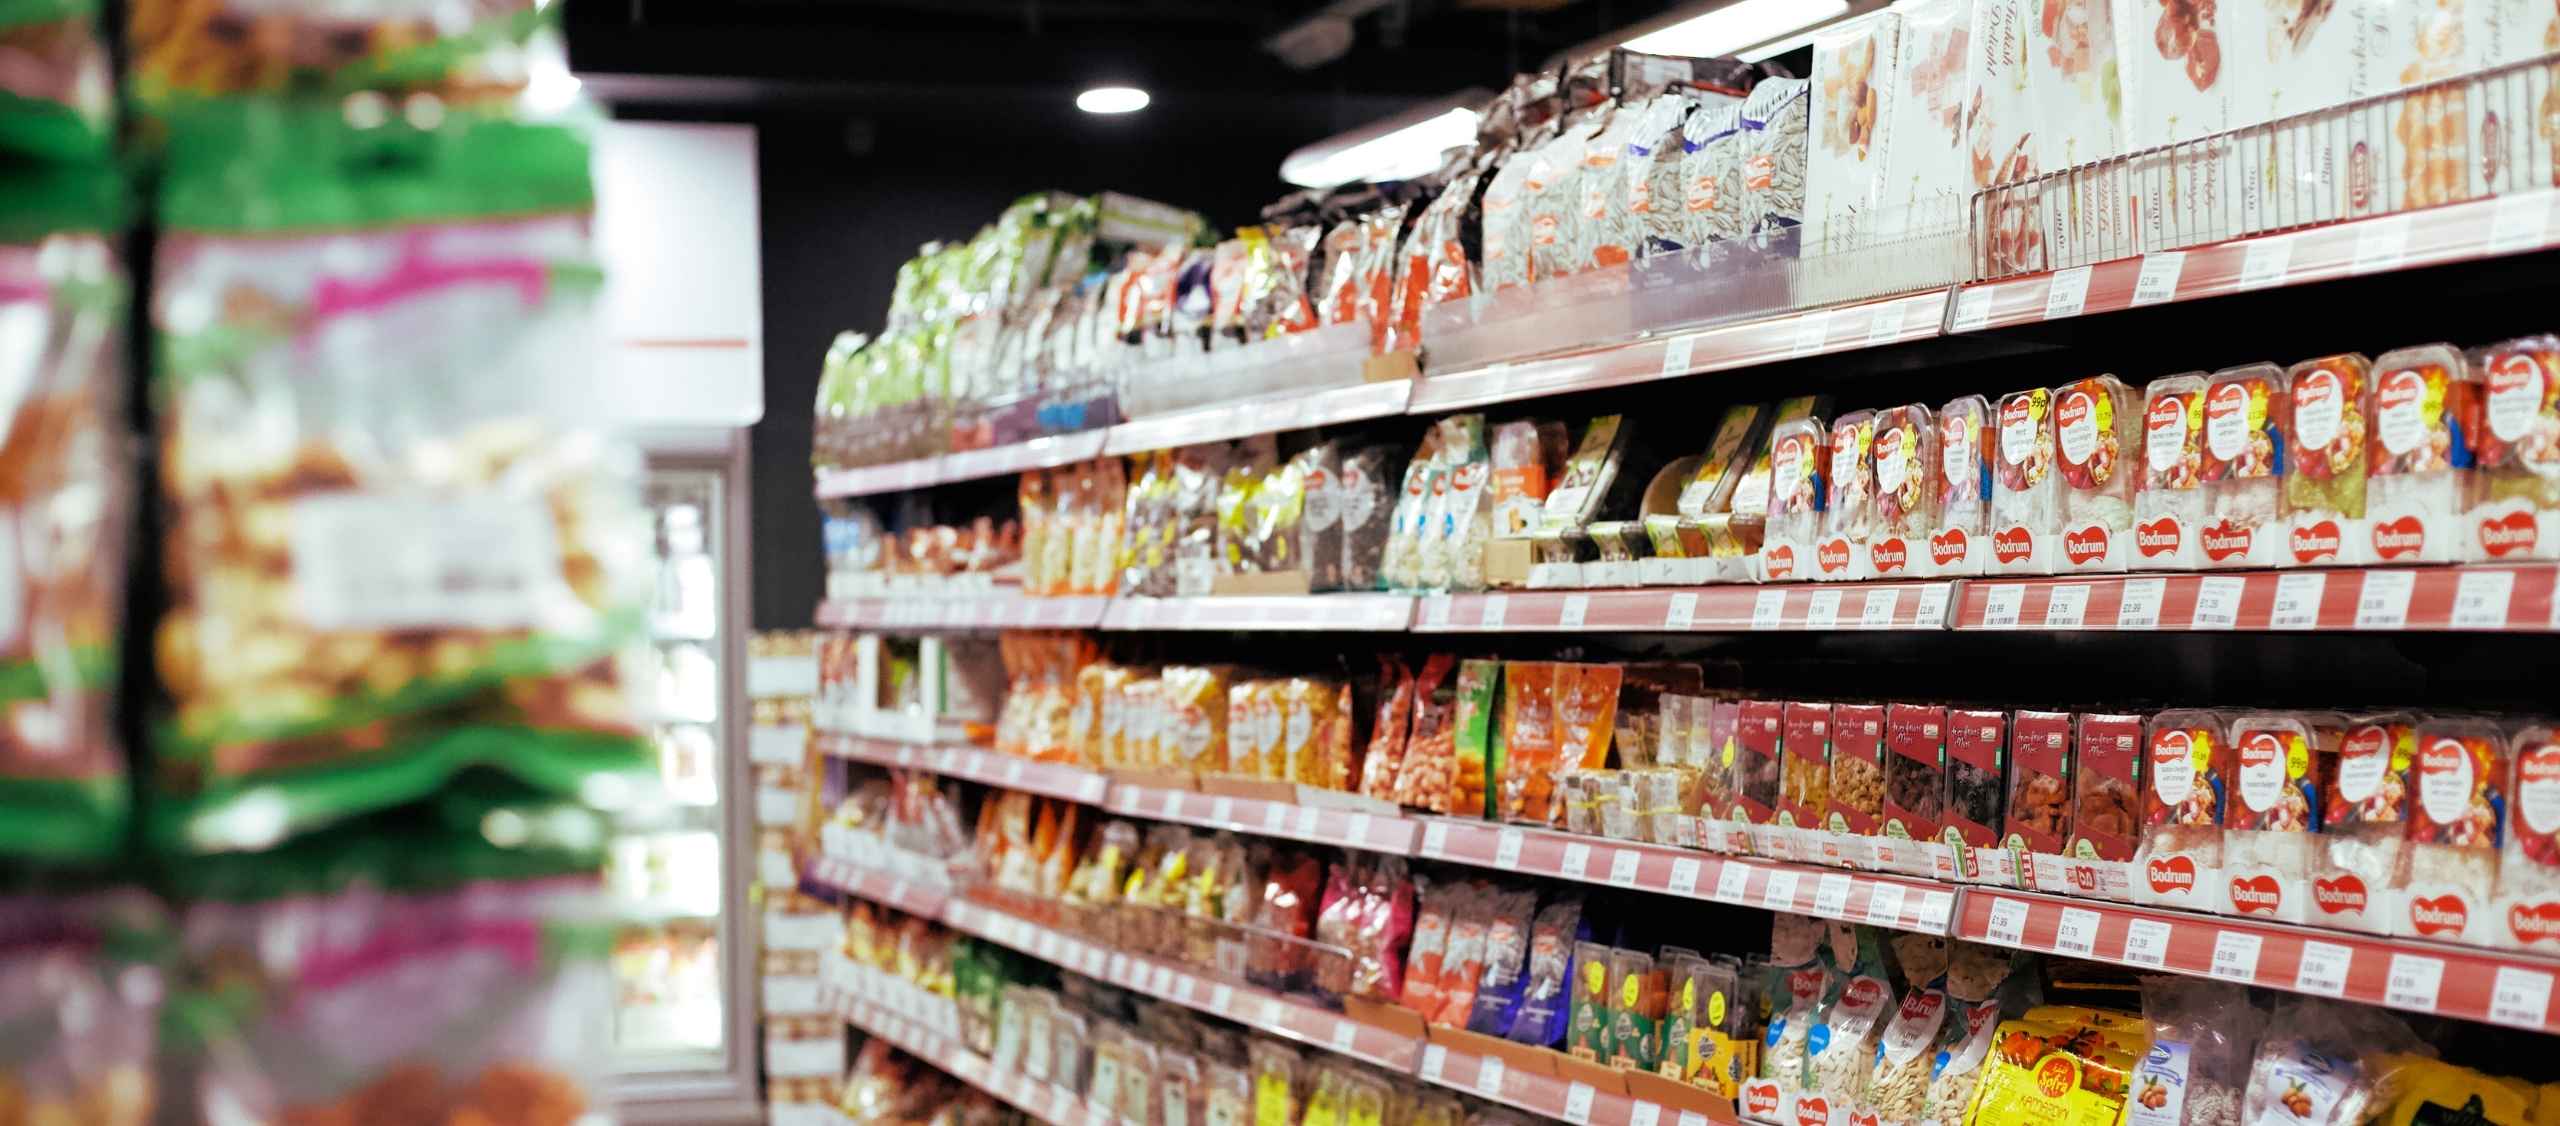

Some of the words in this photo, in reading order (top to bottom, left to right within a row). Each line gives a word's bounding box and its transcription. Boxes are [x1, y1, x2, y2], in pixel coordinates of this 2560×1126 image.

[2031, 397, 2047, 409] 99p
[1932, 539, 1965, 555] Bodrum
[1995, 538, 2030, 554] Bodrum
[2068, 539, 2105, 555] Bodrum
[2138, 530, 2178, 548] Bodrum
[1873, 548, 1905, 564] Bodrum
[2150, 867, 2193, 884] Bodrum
[2232, 885, 2278, 904] Bodrum
[2317, 885, 2365, 904] Bodrum
